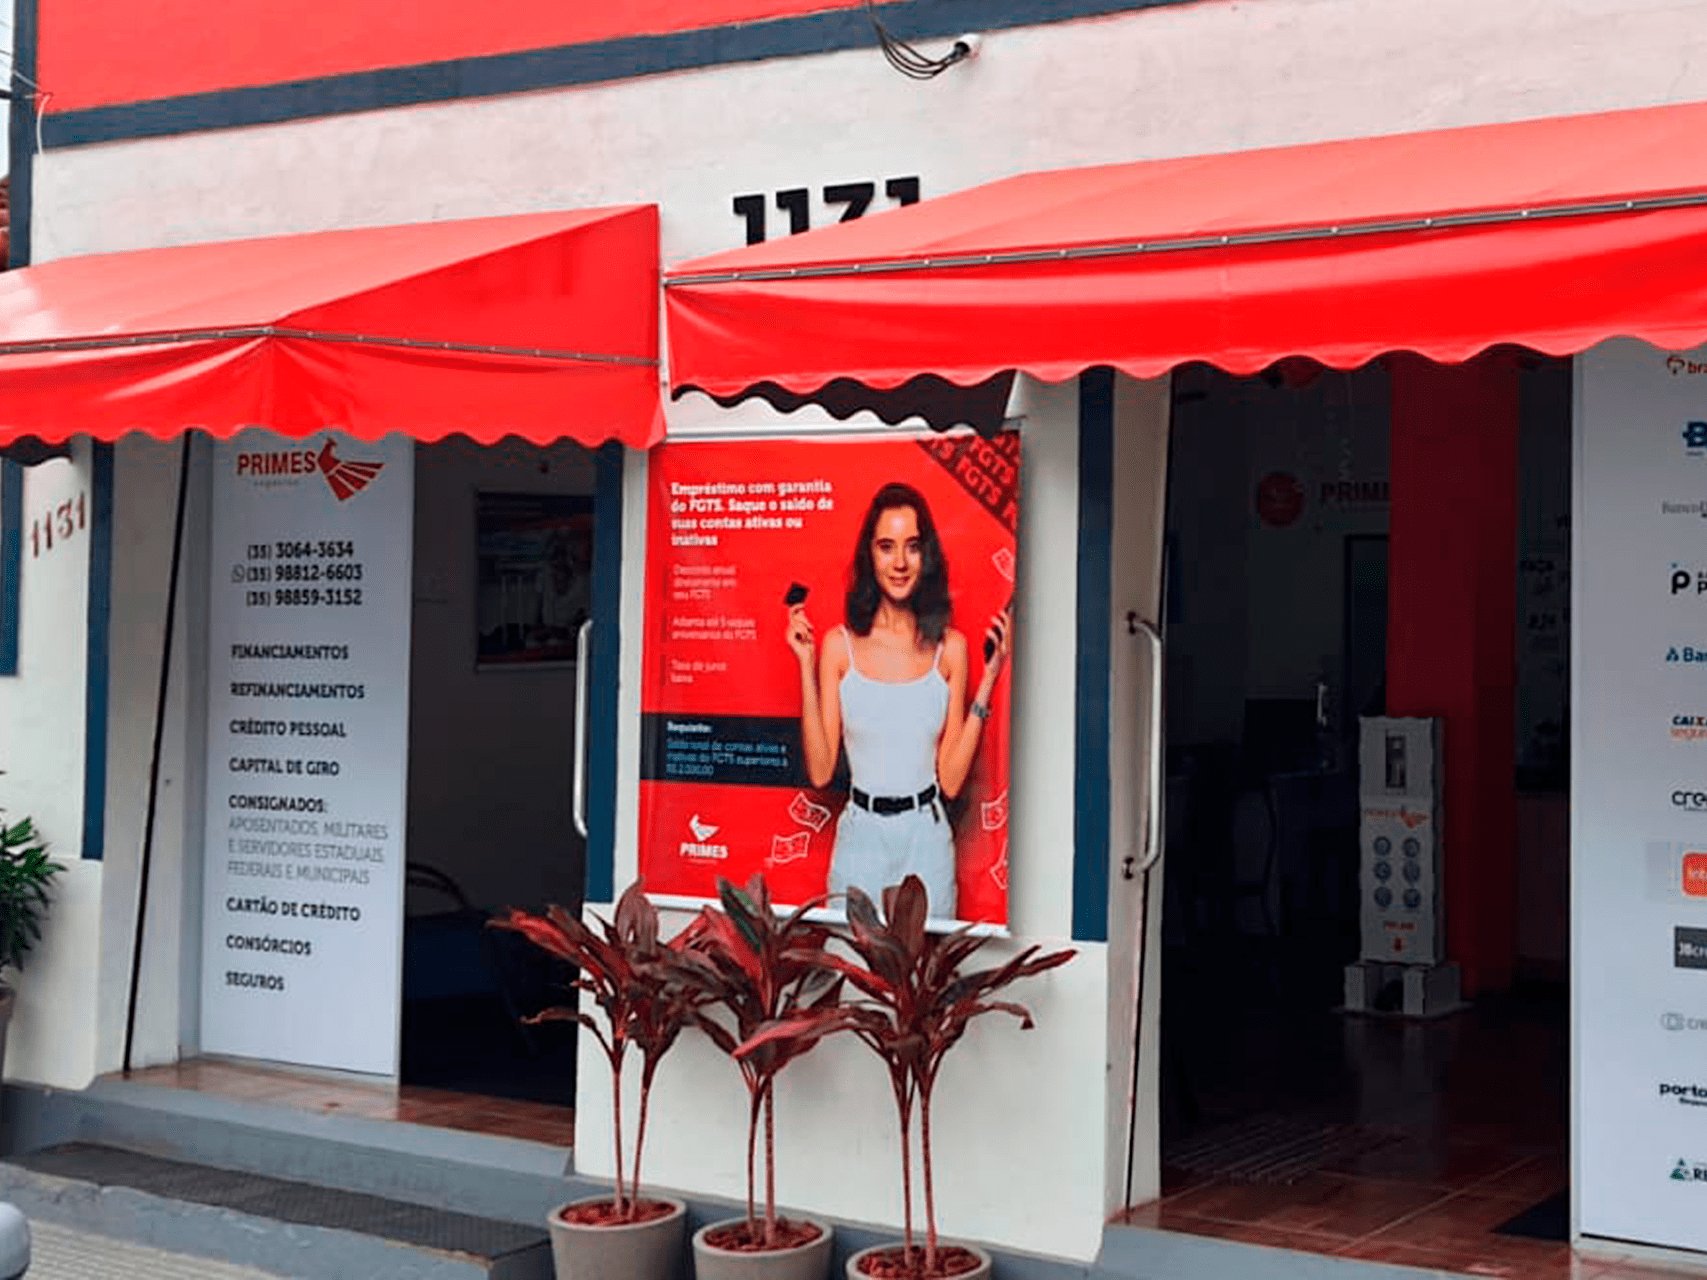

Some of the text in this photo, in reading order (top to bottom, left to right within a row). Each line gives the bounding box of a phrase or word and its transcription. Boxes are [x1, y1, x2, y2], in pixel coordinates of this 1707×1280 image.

[237, 450, 317, 476] PRIMES
[748, 483, 776, 495] com
[778, 480, 832, 498] garantia
[728, 498, 767, 515] Saque
[780, 497, 815, 512] saldo
[817, 496, 833, 510] de
[32, 491, 85, 559] 1131
[671, 514, 803, 531] suas contas ativas ou
[671, 532, 719, 547] inativas
[275, 563, 363, 581] 98812-6603
[231, 644, 350, 661] FINANCIAMENTOS
[230, 682, 366, 699] REFINANCIAMENTOS
[229, 717, 347, 738] CRÉDITO PESSOAL
[1672, 716, 1707, 726] CAIX
[229, 757, 340, 776] CAPITAL DE GIRO
[228, 794, 328, 813] CONSIGNADOS:
[323, 821, 389, 841] MILITARES
[228, 838, 235, 853] E
[238, 838, 312, 859] SERVIDORES
[680, 842, 728, 859] PRIMES
[227, 860, 370, 885] FEDERAIS E MUNICIPAIS
[226, 895, 361, 922] CARTÃO DE CRÉDITO
[226, 933, 312, 956] CONSÓRCIOS
[225, 970, 285, 991] SEGUROS
